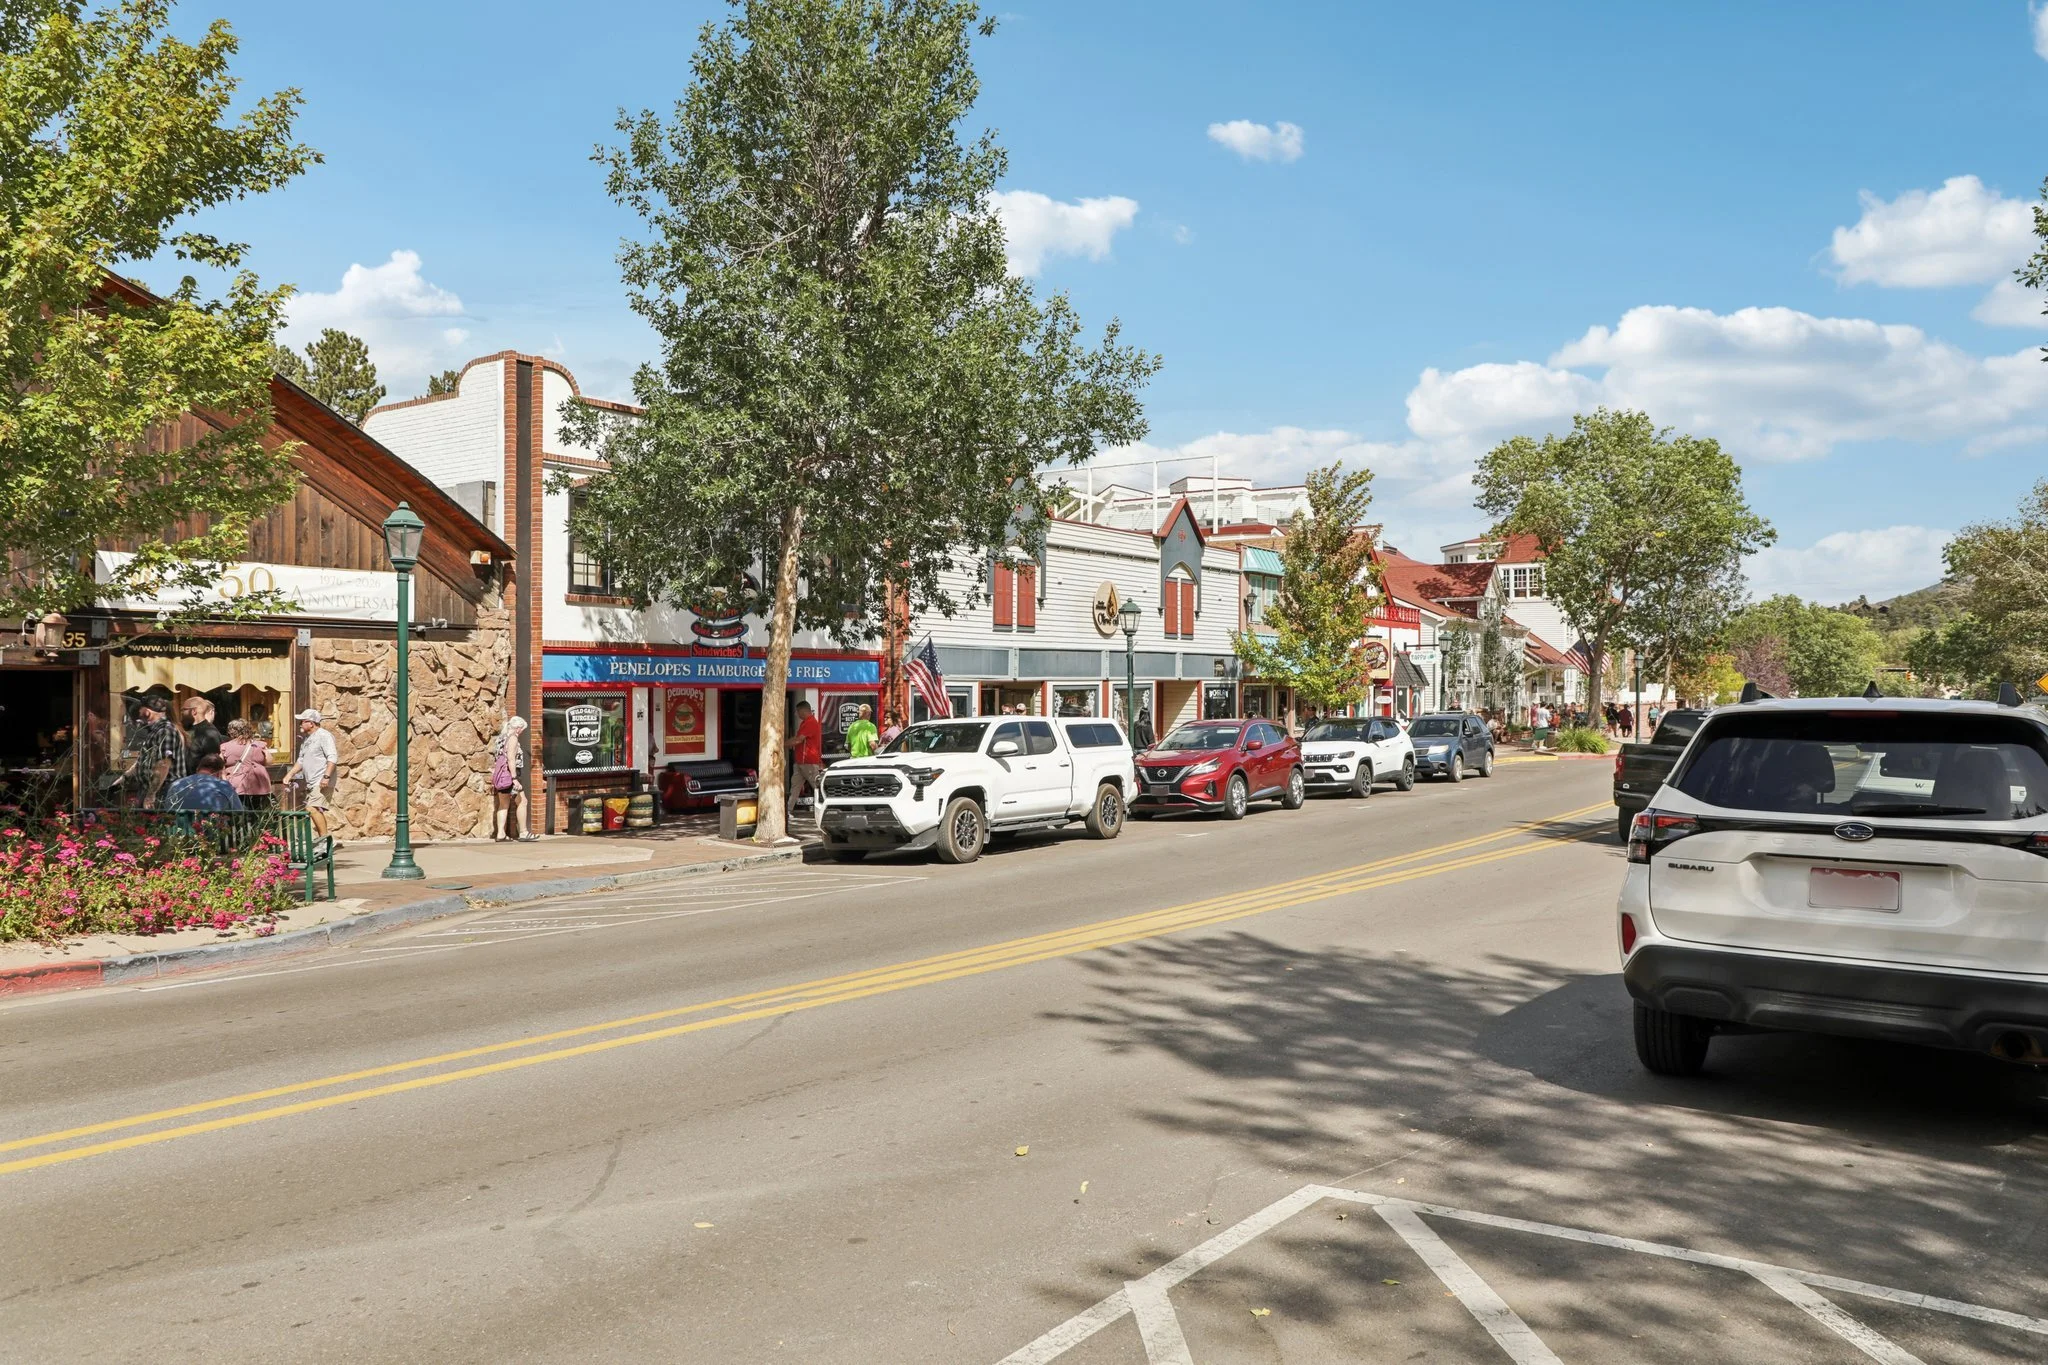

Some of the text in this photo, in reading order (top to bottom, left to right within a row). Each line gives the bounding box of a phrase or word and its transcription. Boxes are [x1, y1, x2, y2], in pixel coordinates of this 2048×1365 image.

[218, 566, 275, 598] 50
[319, 575, 341, 586] 1976
[354, 577, 381, 589] 2026
[290, 585, 398, 610] ANNIVERSAR
[610, 661, 691, 677] PENELOPE'S
[697, 663, 765, 678] HAMBURGE
[796, 666, 831, 678] FRIES
[1667, 862, 1715, 872] SUBARU
